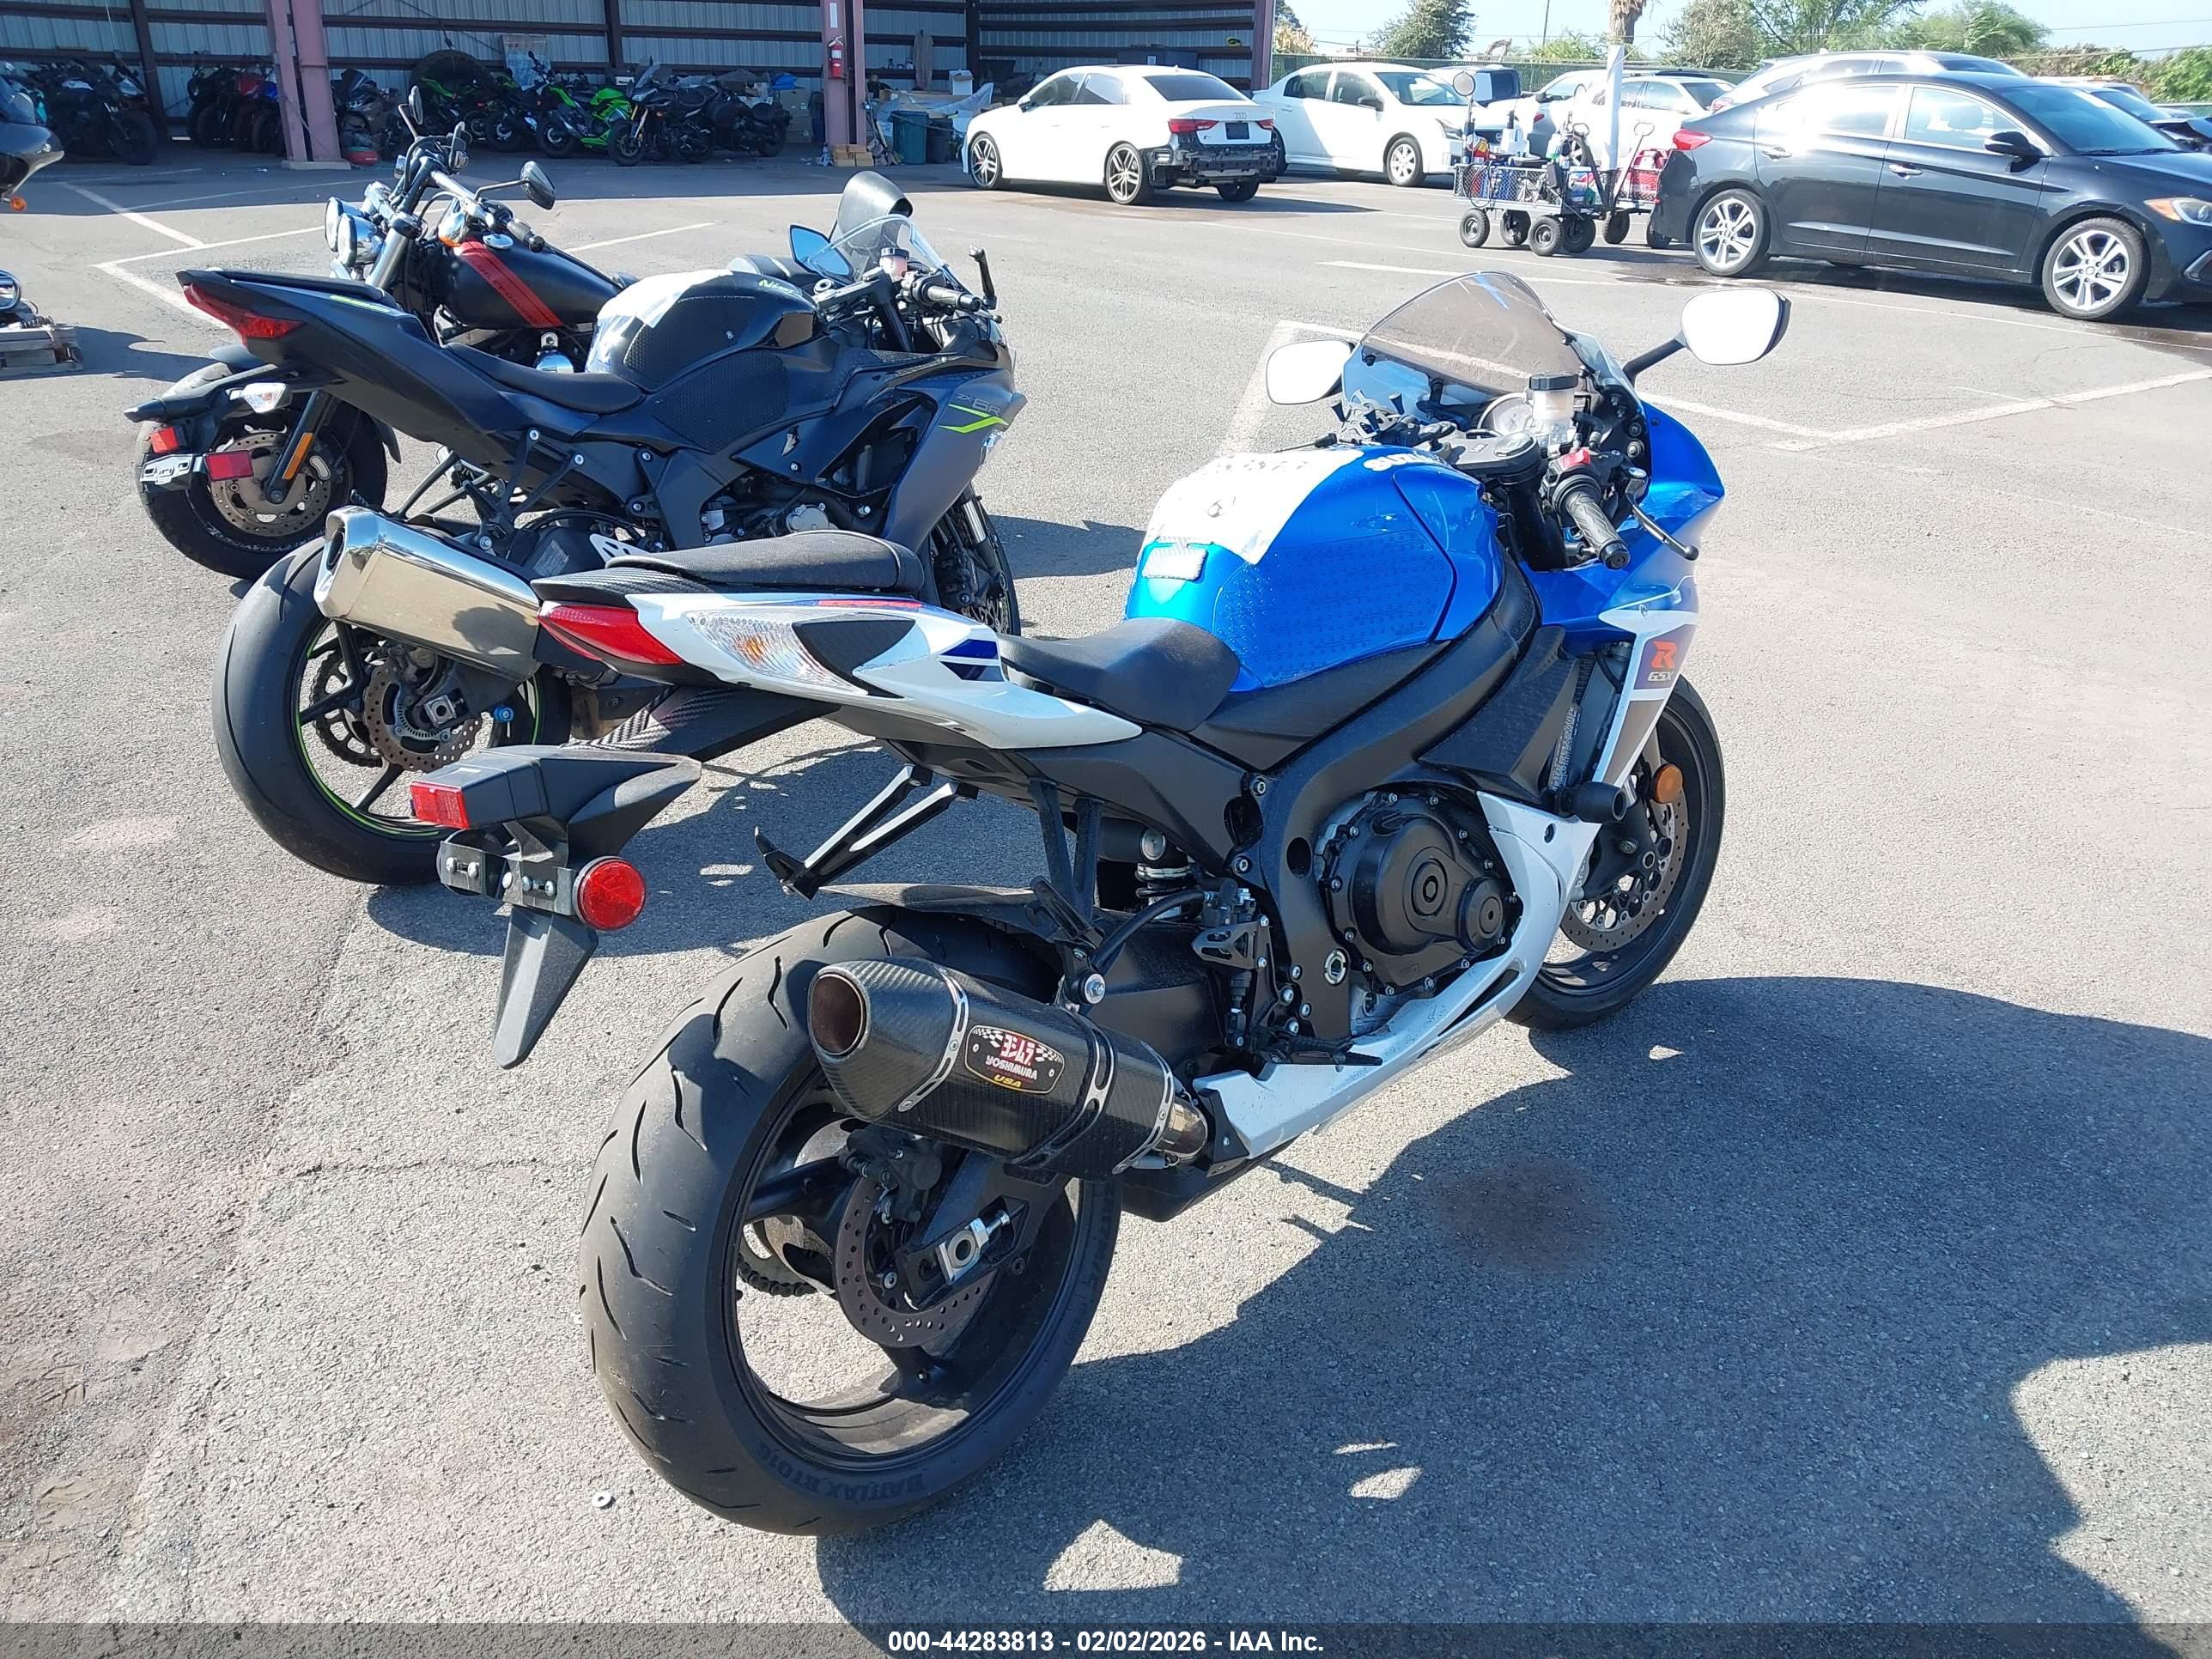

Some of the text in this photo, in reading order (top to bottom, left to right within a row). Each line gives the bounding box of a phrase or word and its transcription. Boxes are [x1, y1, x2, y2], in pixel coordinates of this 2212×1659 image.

[1651, 641, 1676, 669] R
[1648, 672, 1674, 682] GSX
[985, 1054, 1037, 1080] YOSHIMURA
[994, 1073, 1022, 1088] USA
